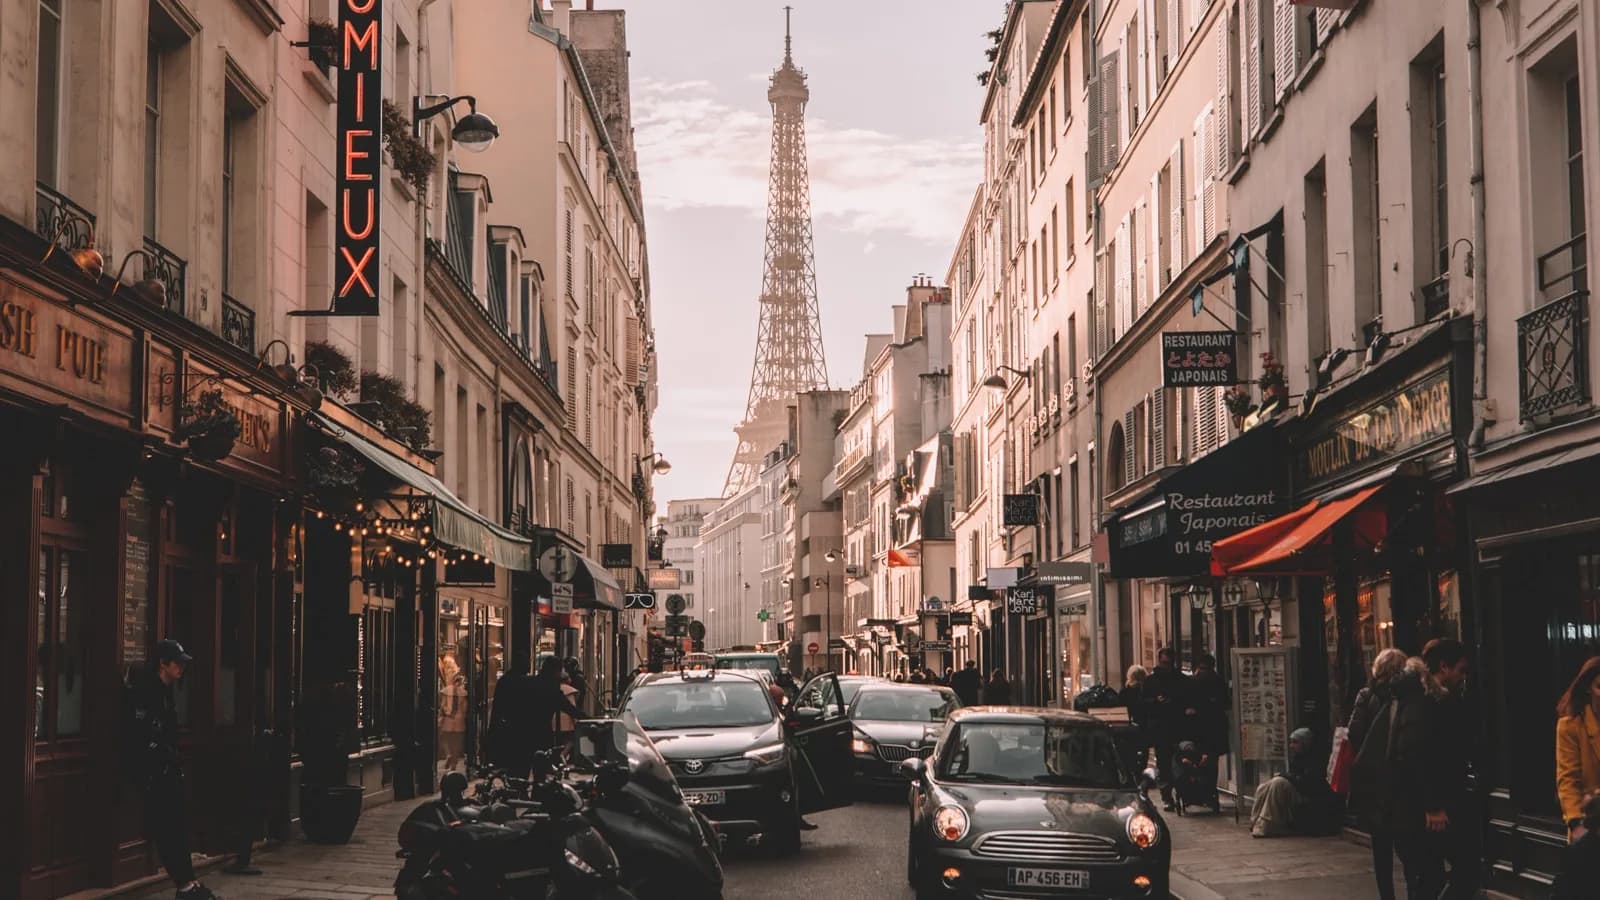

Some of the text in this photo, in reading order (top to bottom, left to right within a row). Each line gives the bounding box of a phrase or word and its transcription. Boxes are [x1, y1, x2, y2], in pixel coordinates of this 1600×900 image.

[338, 0, 378, 298] MIEUX
[1164, 334, 1232, 348] RESTAURANT
[55, 323, 107, 385] PUB
[1171, 370, 1228, 383] JAPONAIS
[1308, 429, 1350, 477] MOULIN
[1168, 490, 1275, 510] Restaurant
[1180, 512, 1266, 534] Japonais
[1175, 541, 1212, 554] 01 45
[1008, 596, 1035, 606] Marc
[1012, 589, 1035, 598] Karl
[1009, 604, 1036, 613] John
[1017, 870, 1080, 886] AP-456-EH
